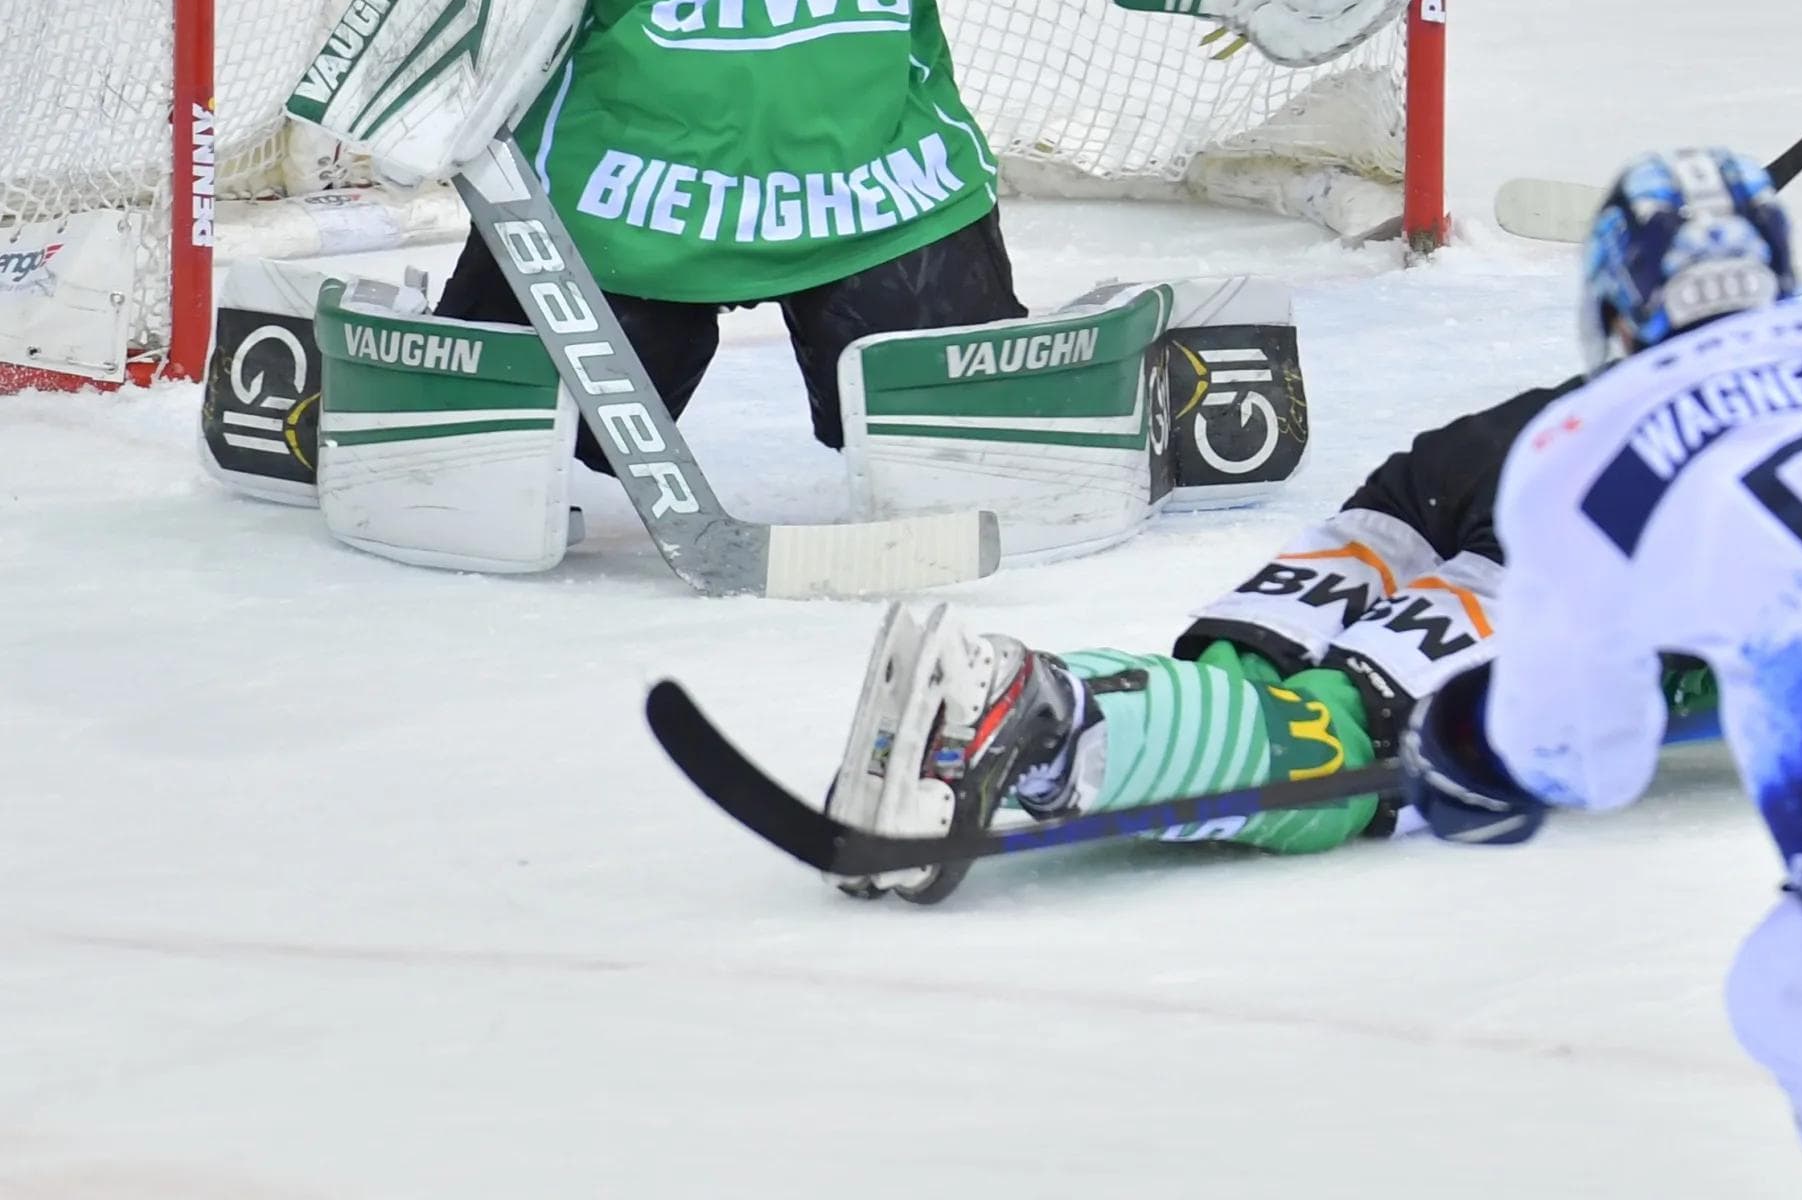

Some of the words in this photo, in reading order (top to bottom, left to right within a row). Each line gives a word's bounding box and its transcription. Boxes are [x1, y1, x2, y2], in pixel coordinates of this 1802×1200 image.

[577, 133, 964, 244] BIETIGHEIM
[342, 322, 484, 376] VAUGHN
[492, 217, 700, 520] BAUER
[945, 327, 1100, 381] VAUGHN
[1234, 562, 1383, 630] BW
